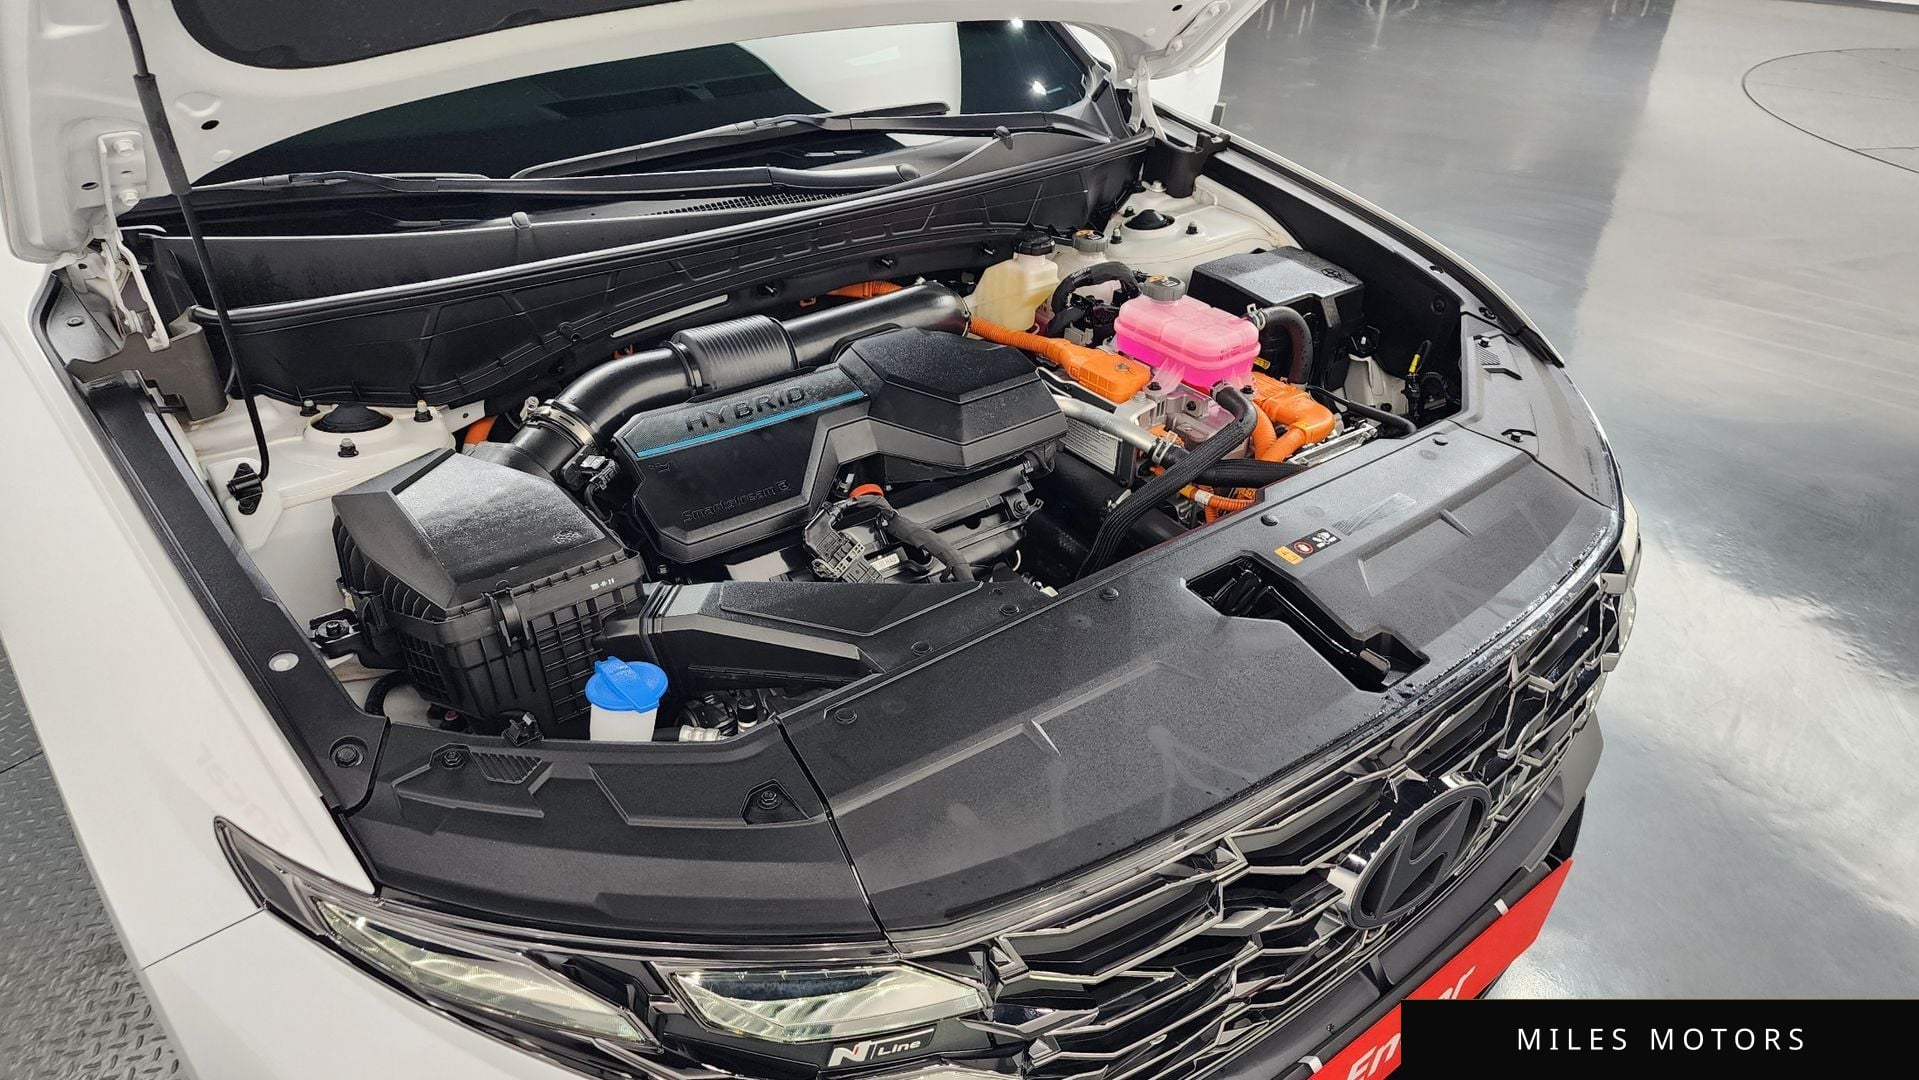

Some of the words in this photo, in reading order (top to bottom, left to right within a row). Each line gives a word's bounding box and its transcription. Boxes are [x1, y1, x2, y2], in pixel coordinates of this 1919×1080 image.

[685, 386, 805, 432] HYBRID
[682, 486, 776, 522] Smartstream
[828, 1040, 872, 1067] N
[877, 1041, 921, 1056] Line
